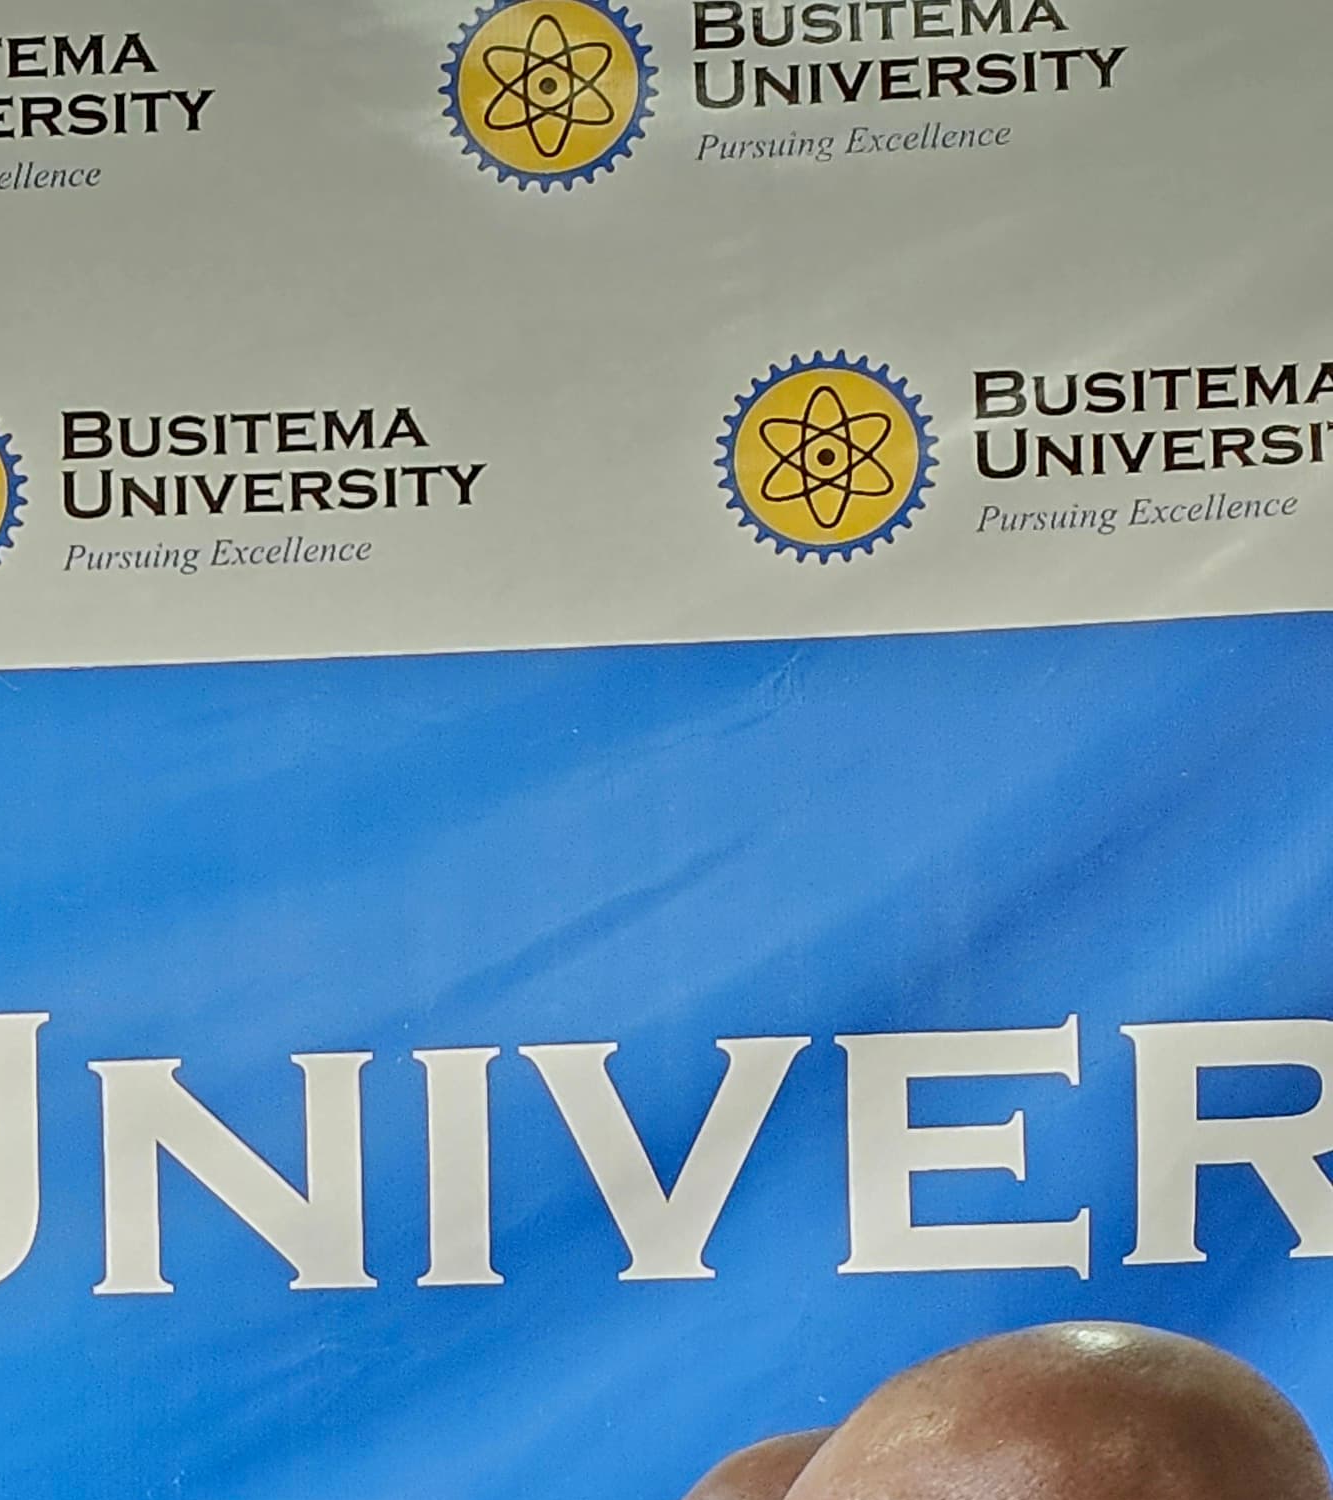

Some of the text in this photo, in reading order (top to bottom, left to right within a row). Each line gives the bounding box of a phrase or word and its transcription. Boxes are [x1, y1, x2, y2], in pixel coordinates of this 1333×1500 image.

[693, 0, 1069, 51] BUSITEMA
[694, 47, 1129, 108] UNIVERSITY
[695, 122, 1010, 161] Pursuing Excellence
[61, 407, 429, 460] BUSITEMA
[975, 421, 1333, 479] UNIVERSI
[62, 463, 487, 519] UNIVERSITY
[976, 493, 1298, 535] Pursuing Excellence
[63, 536, 372, 575] Pursuing Excellence
